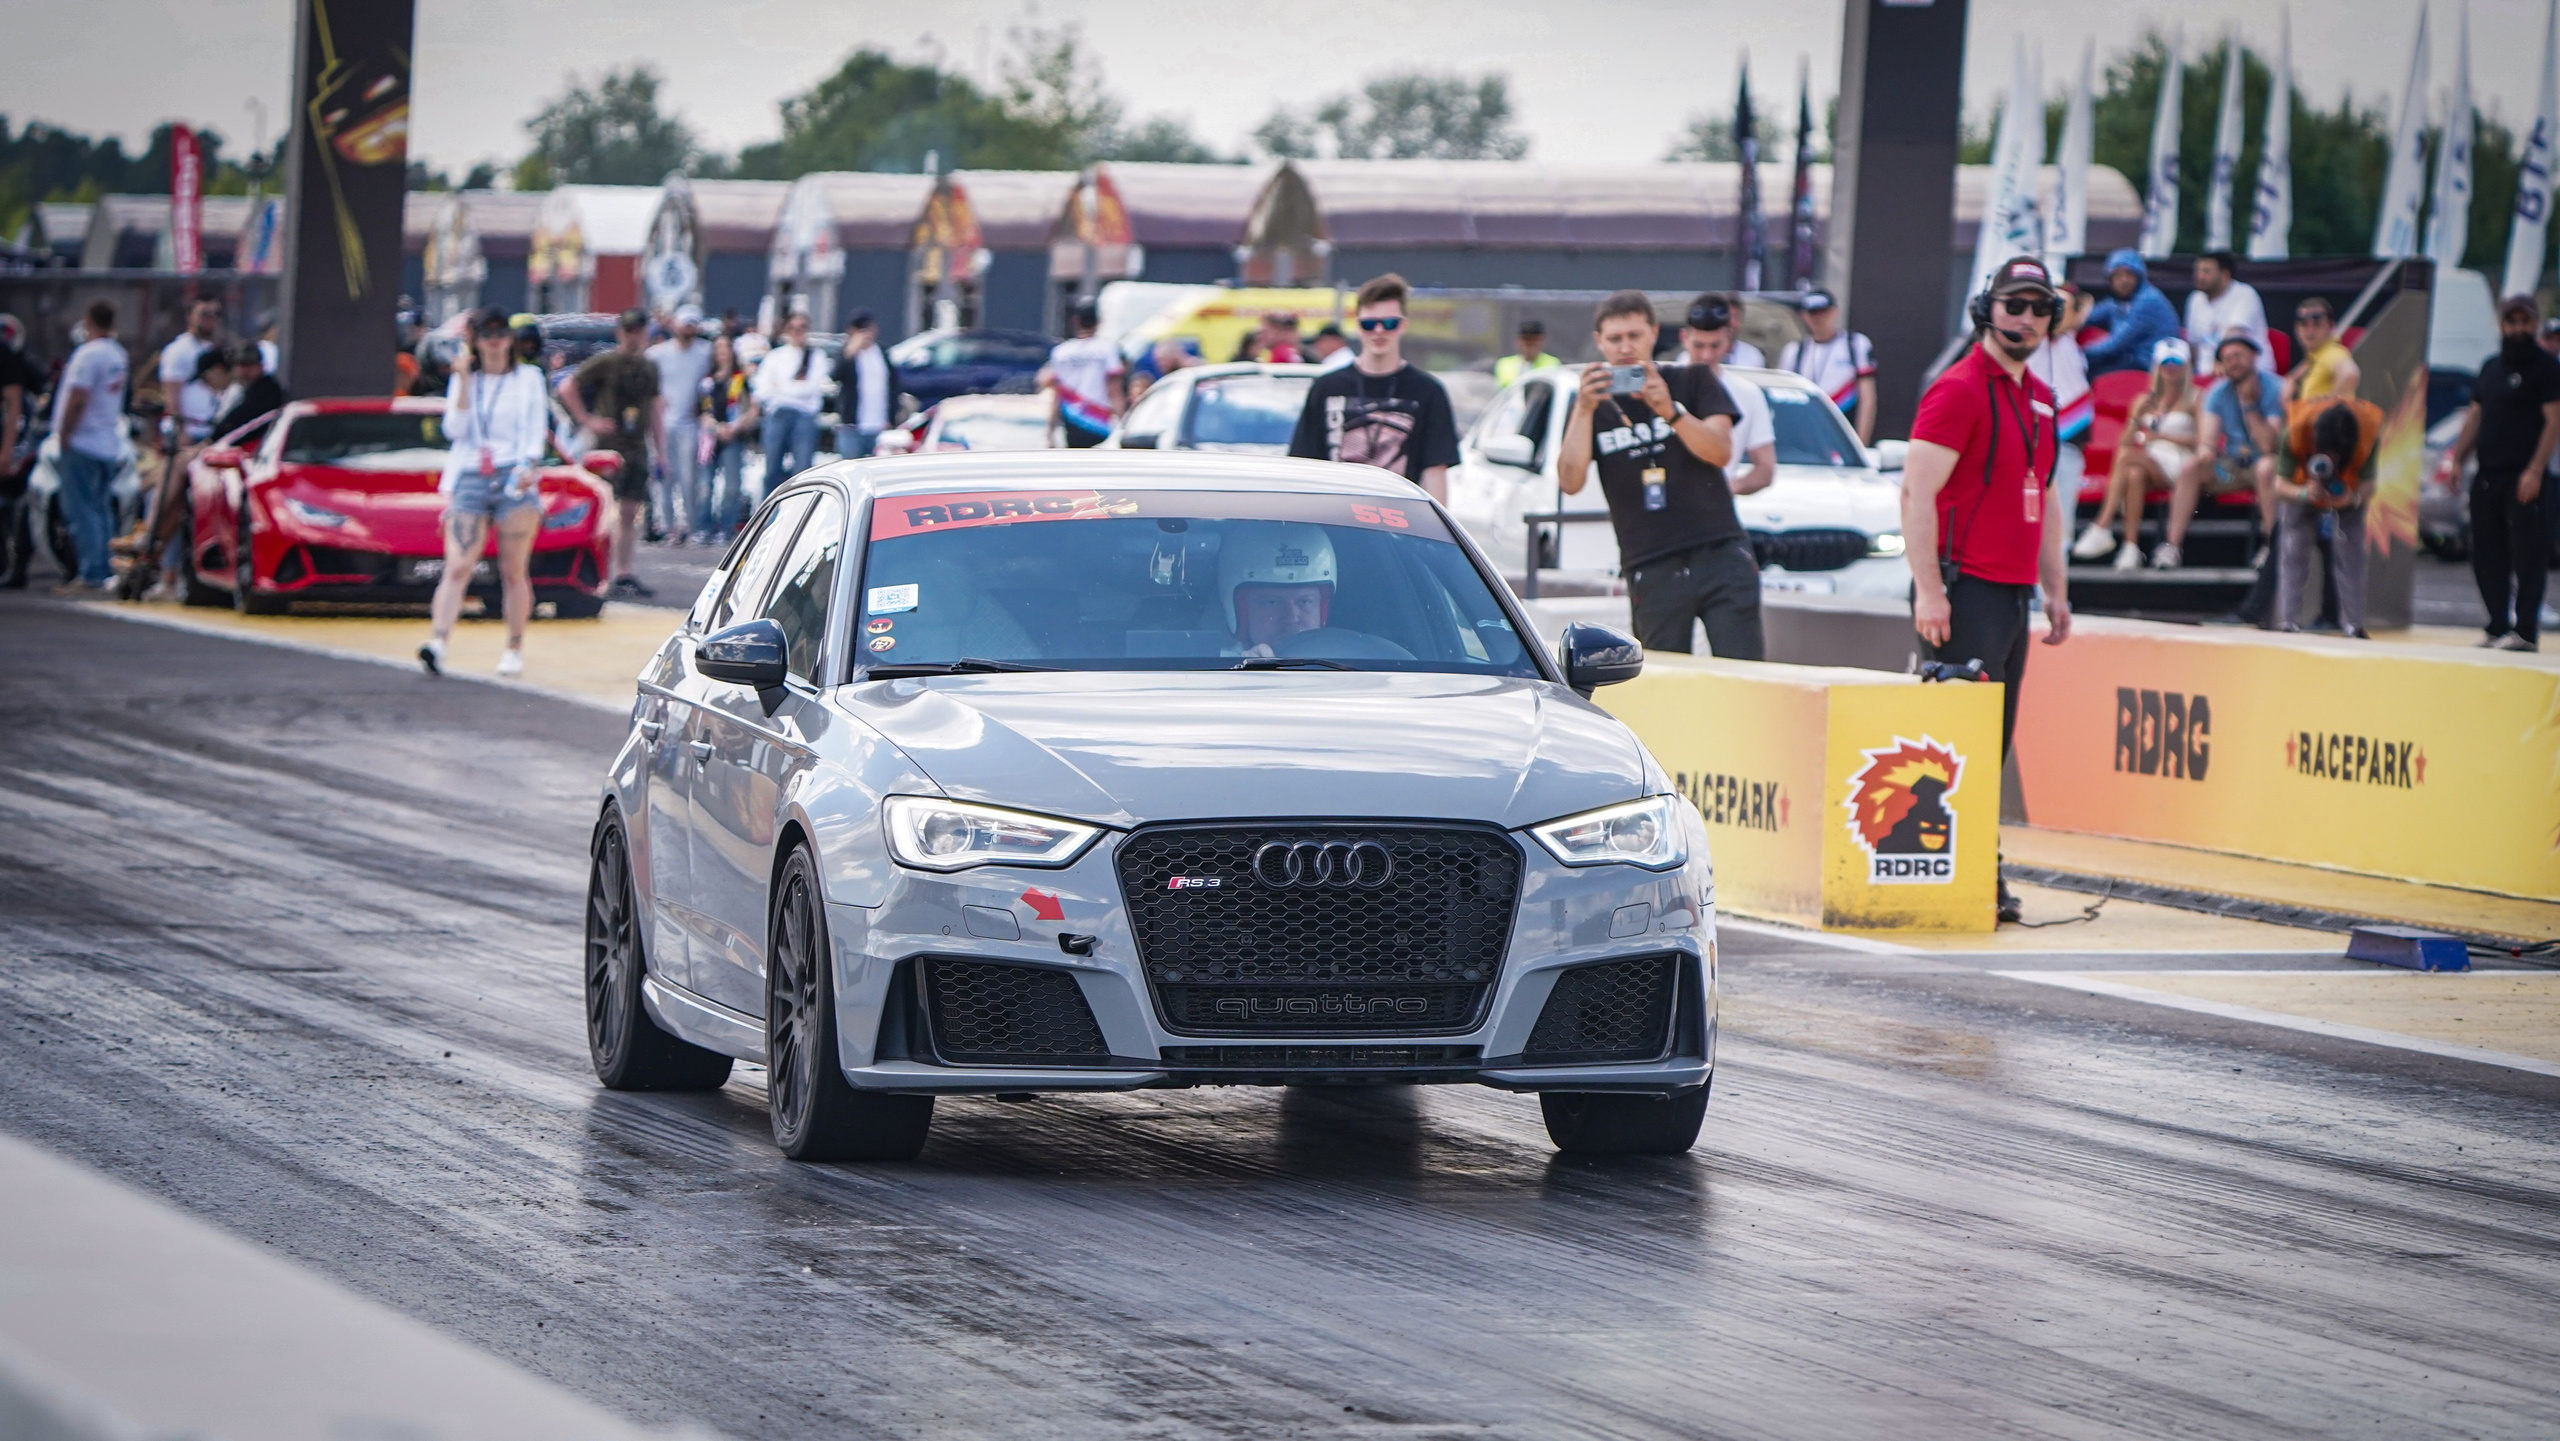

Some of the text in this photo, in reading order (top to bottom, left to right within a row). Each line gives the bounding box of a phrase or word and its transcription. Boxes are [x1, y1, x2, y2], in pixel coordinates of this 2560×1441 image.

[904, 497, 1074, 527] RDRC
[1351, 503, 1409, 528] 55
[2115, 686, 2211, 782] RDRC
[2299, 731, 2414, 789] RACEPARK
[1875, 858, 1951, 876] RDRC
[1175, 877, 1221, 888] RS 3
[1215, 993, 1428, 1020] quattro
